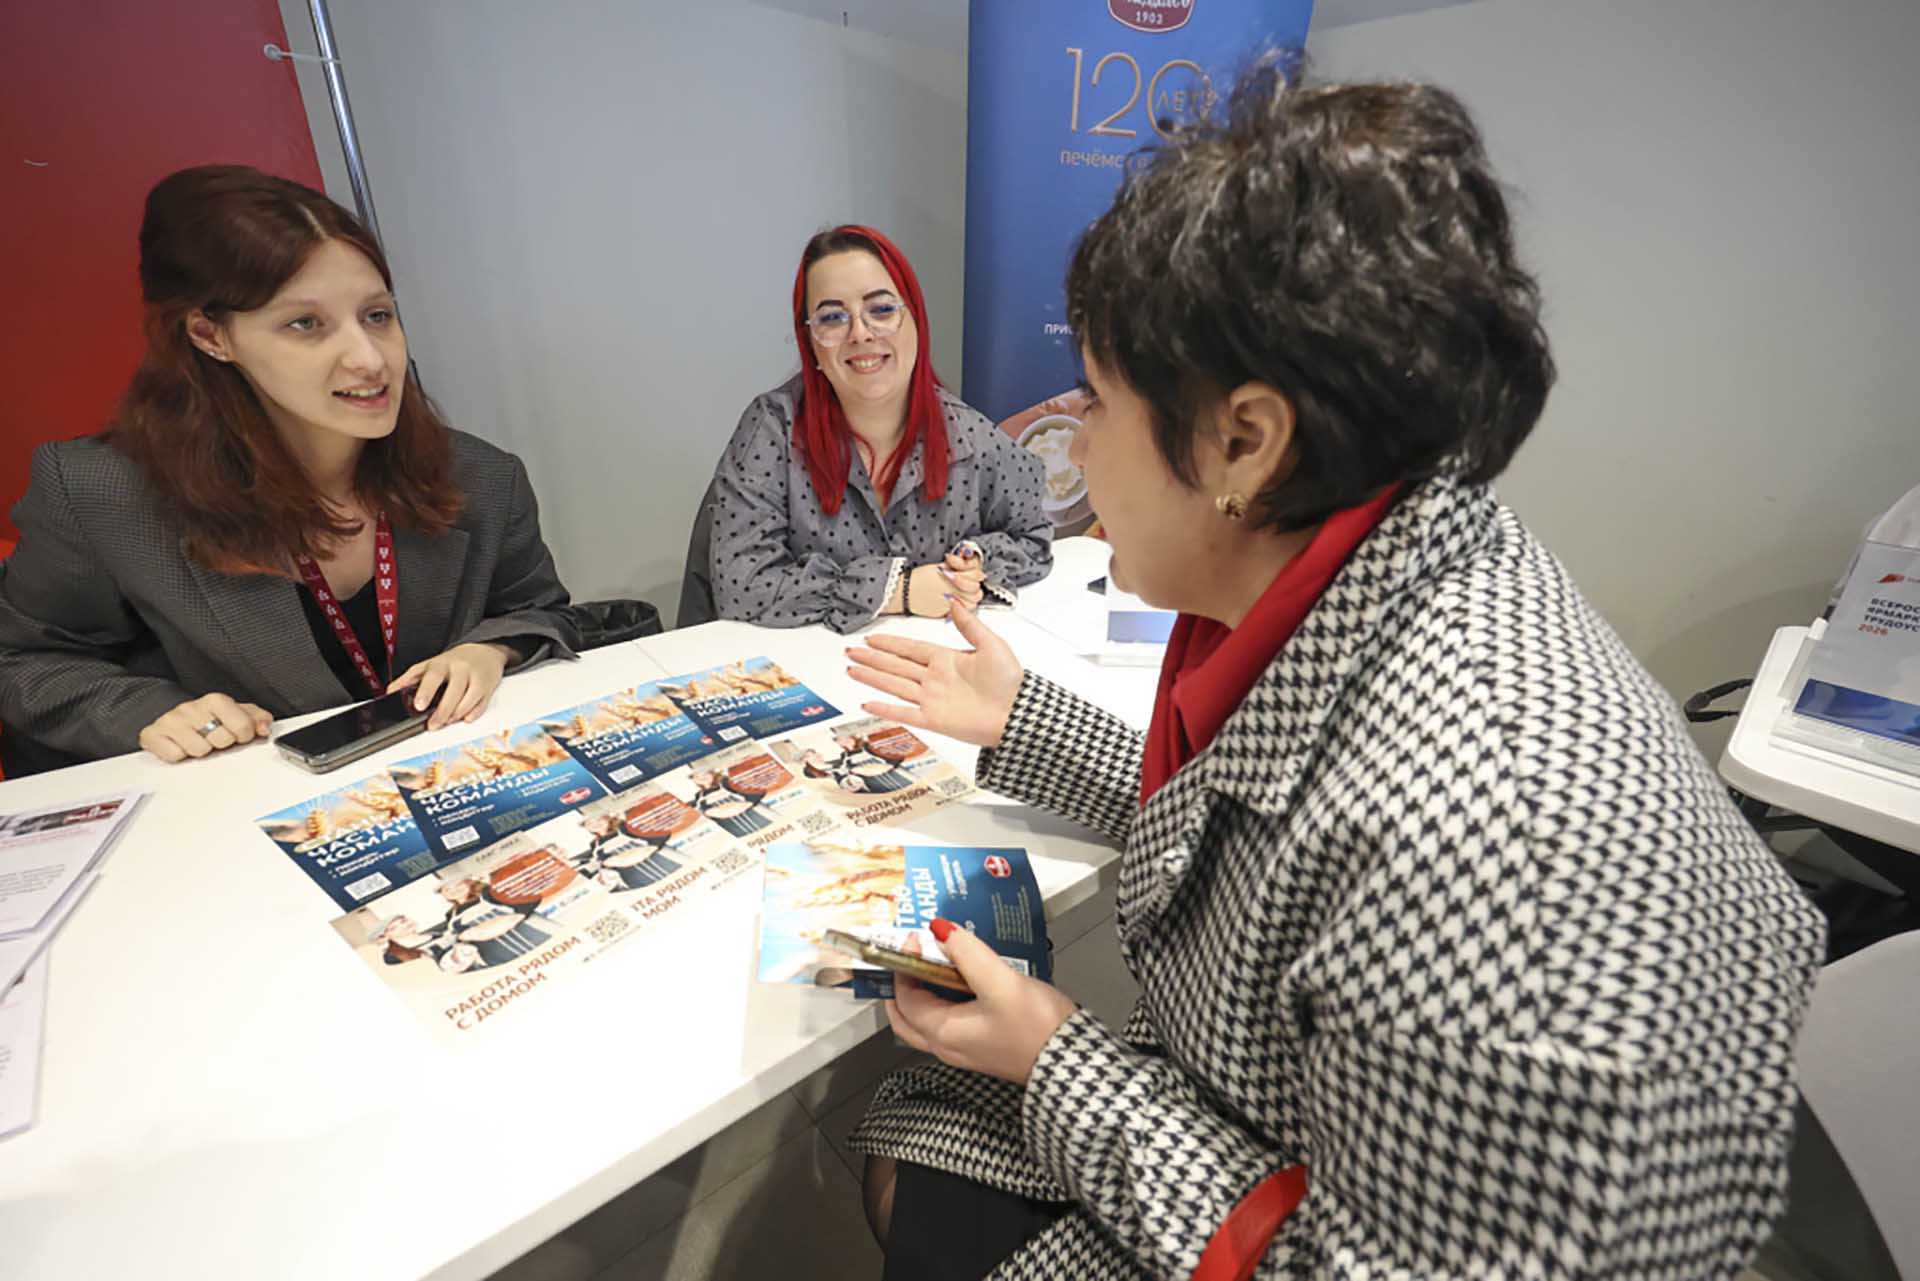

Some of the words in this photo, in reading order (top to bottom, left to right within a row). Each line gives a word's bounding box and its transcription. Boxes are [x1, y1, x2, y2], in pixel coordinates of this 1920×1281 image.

[1066, 47, 1212, 142] 120
[425, 768, 549, 815] КОМАНДЫ
[656, 866, 708, 898] РЯДОМ
[444, 974, 519, 1021] РАБОТА
[518, 935, 582, 978] РЯДОМ
[456, 1018, 472, 1030] С
[475, 971, 548, 1023] ДОМОМ
